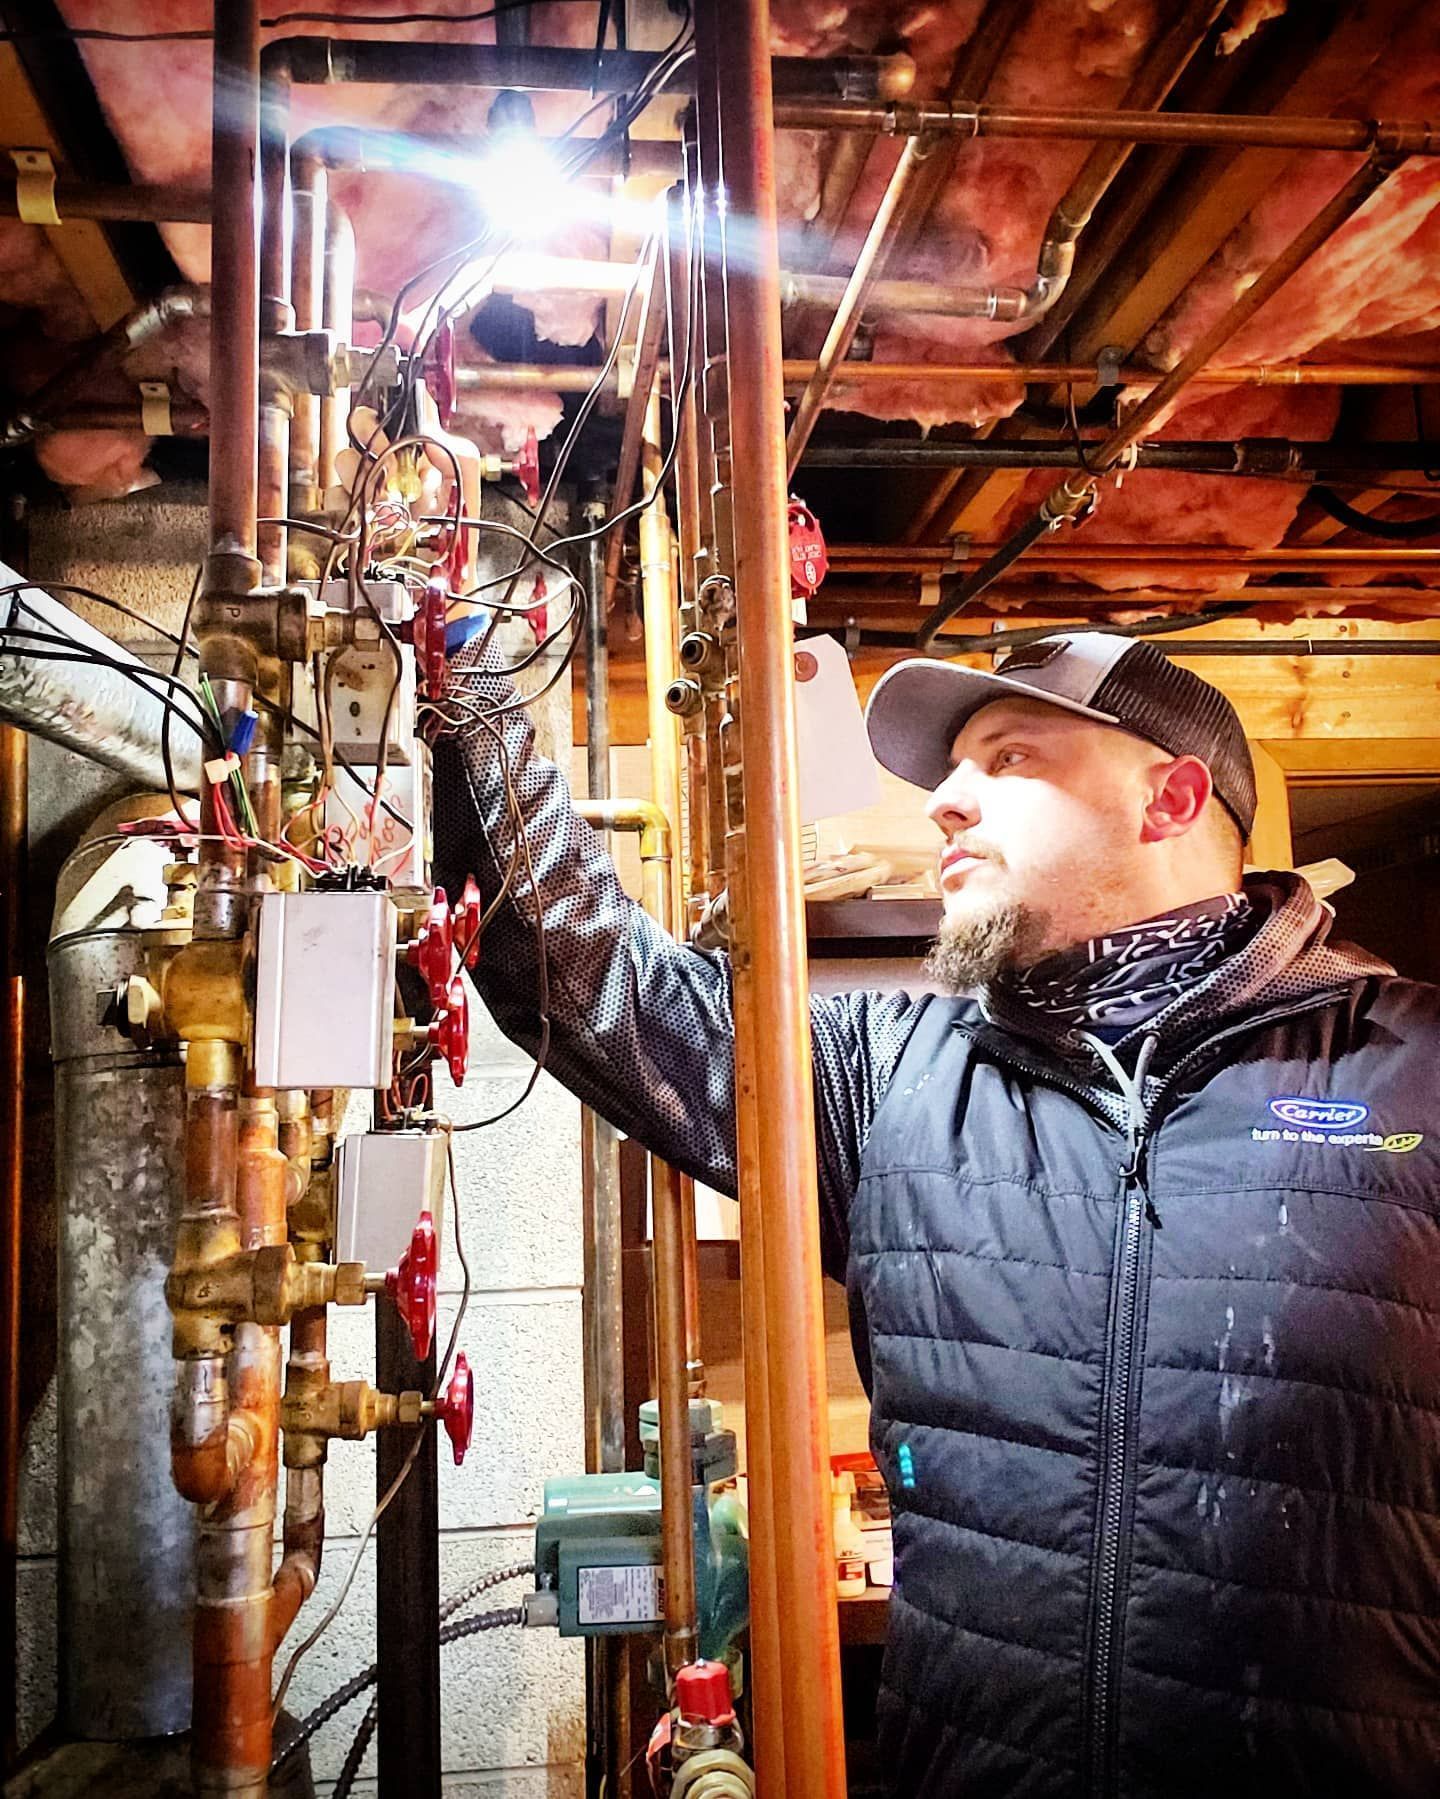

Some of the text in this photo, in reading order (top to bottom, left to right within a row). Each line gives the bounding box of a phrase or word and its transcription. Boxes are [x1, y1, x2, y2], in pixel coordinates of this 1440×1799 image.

[1281, 1103, 1357, 1122] Carrier
[1251, 1127, 1384, 1147] turn to the experts
